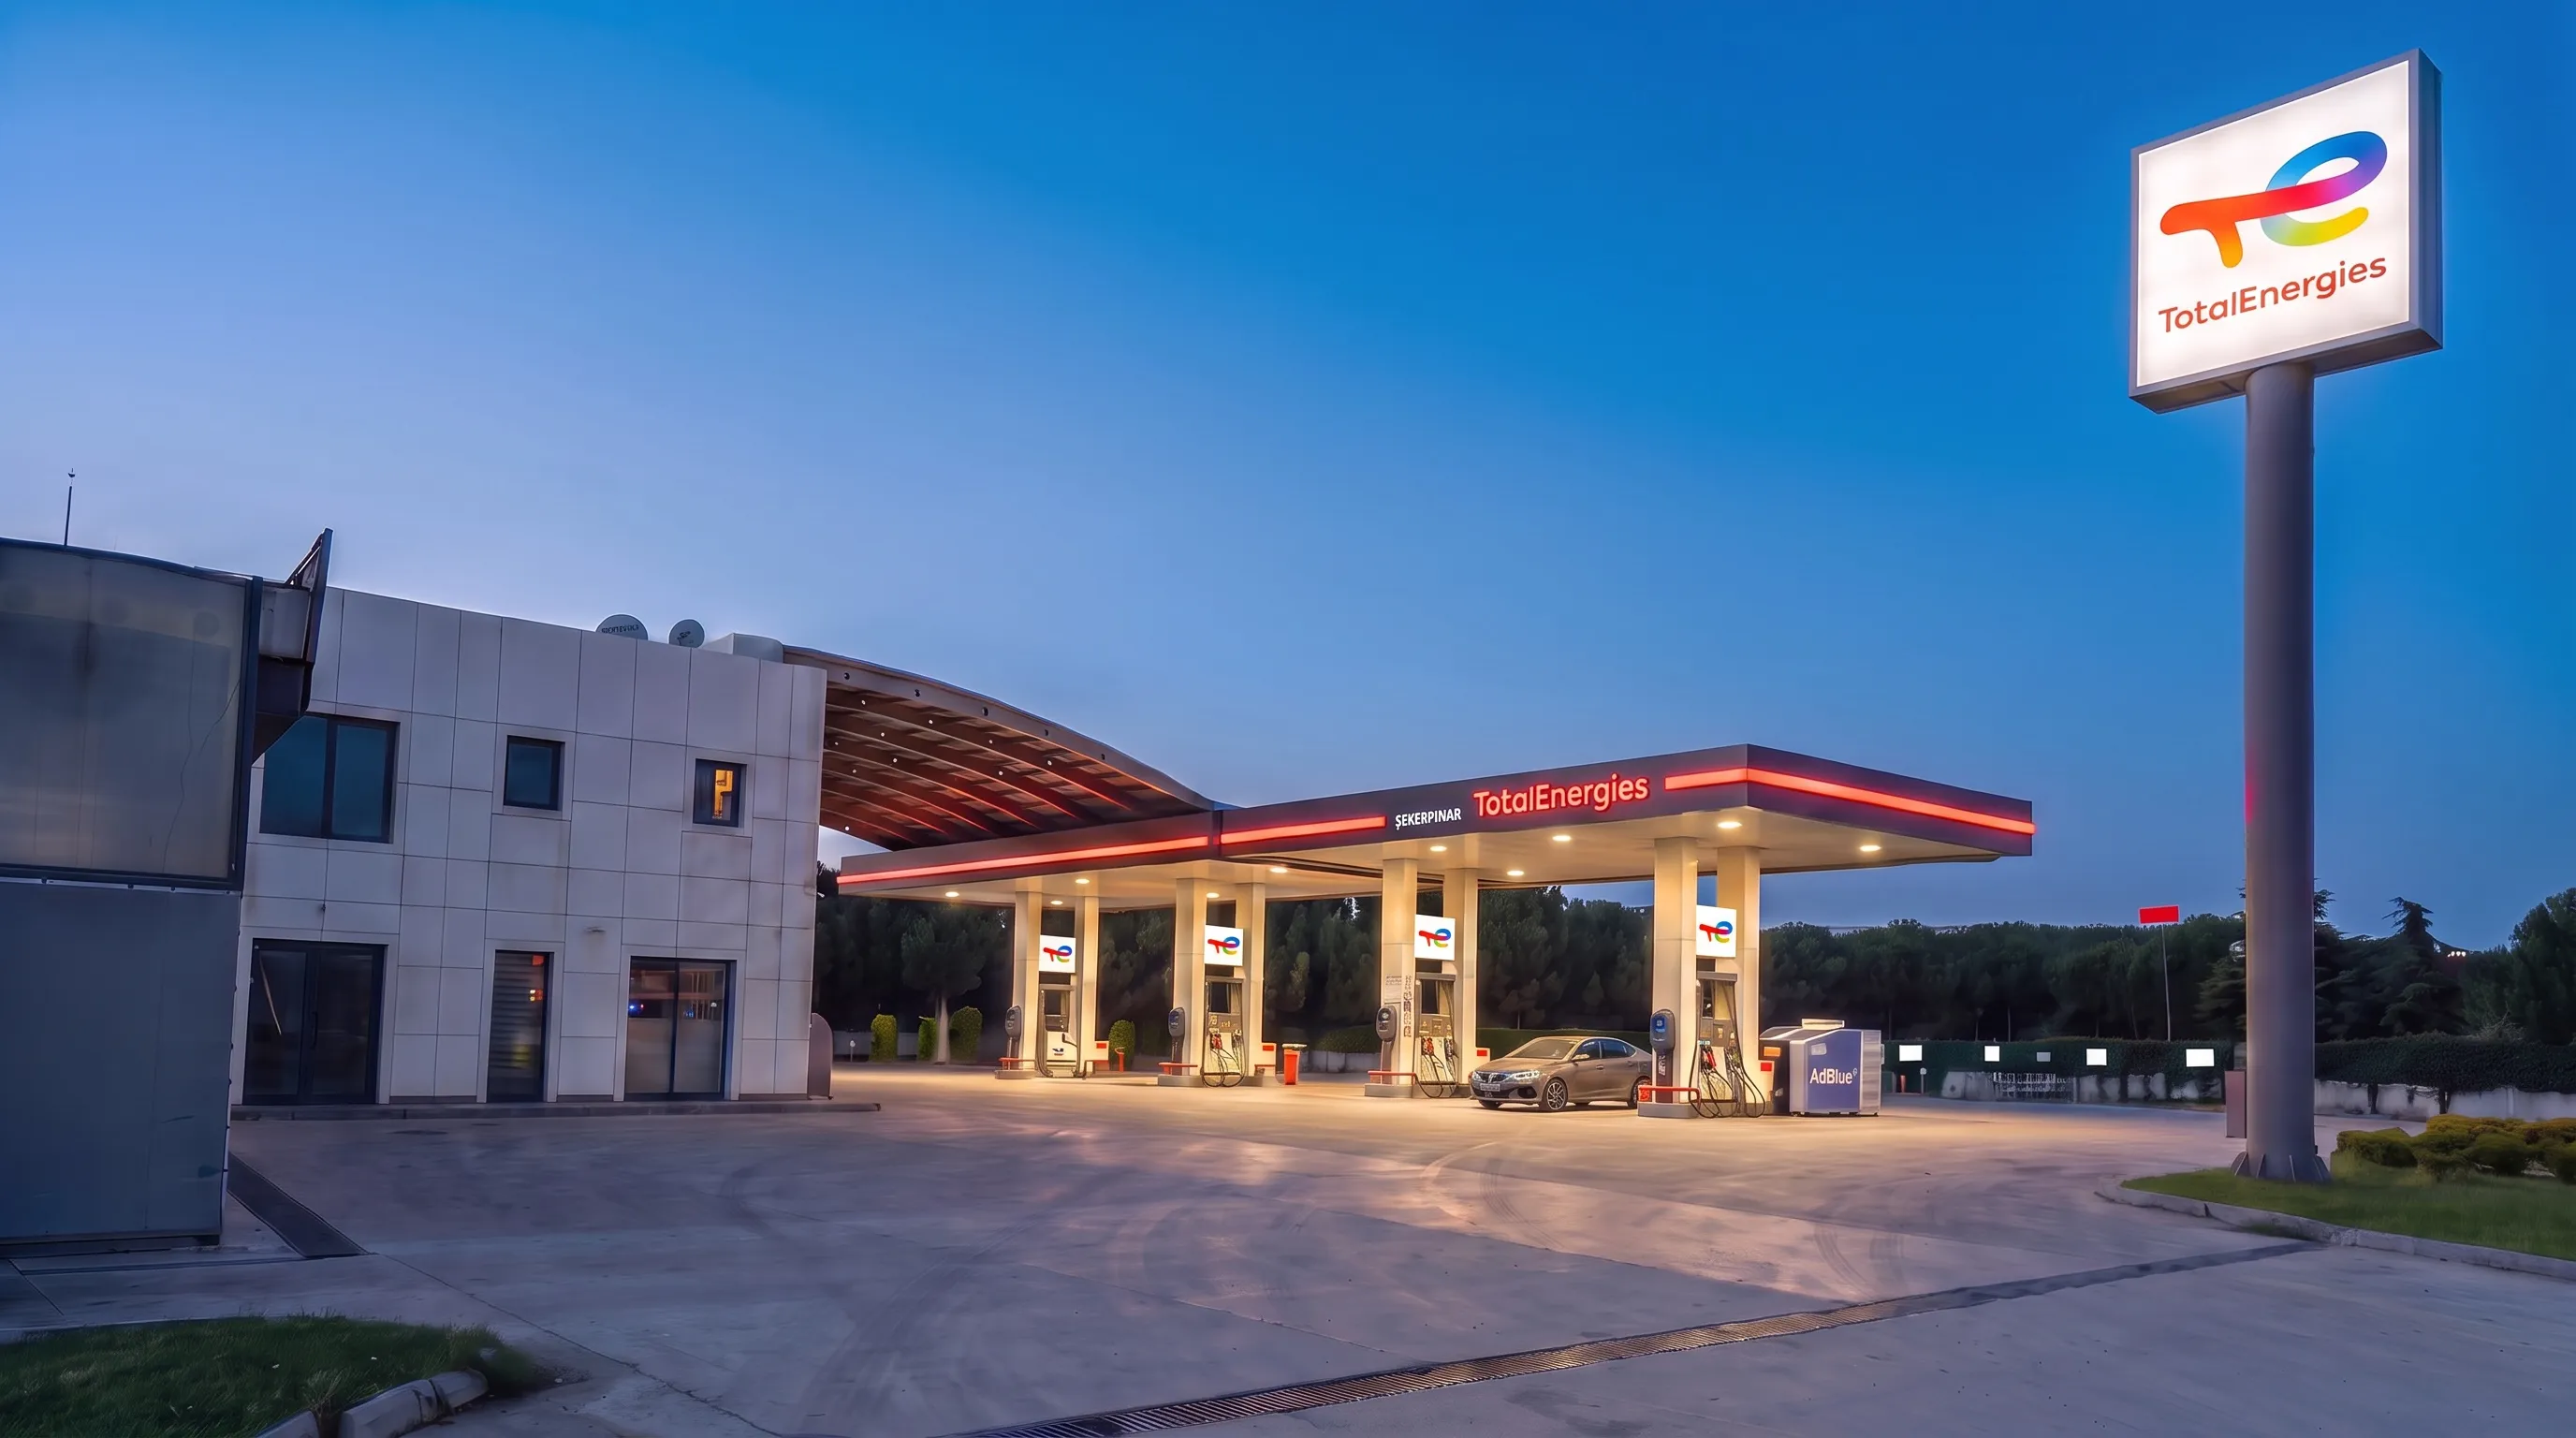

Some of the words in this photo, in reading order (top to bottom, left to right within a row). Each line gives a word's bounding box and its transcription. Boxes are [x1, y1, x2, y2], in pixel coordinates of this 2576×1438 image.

[2158, 257, 2387, 333] TotalEnergies
[1395, 807, 1462, 830] ŞEKERPINAR
[1472, 772, 1649, 817] TotalEnergies
